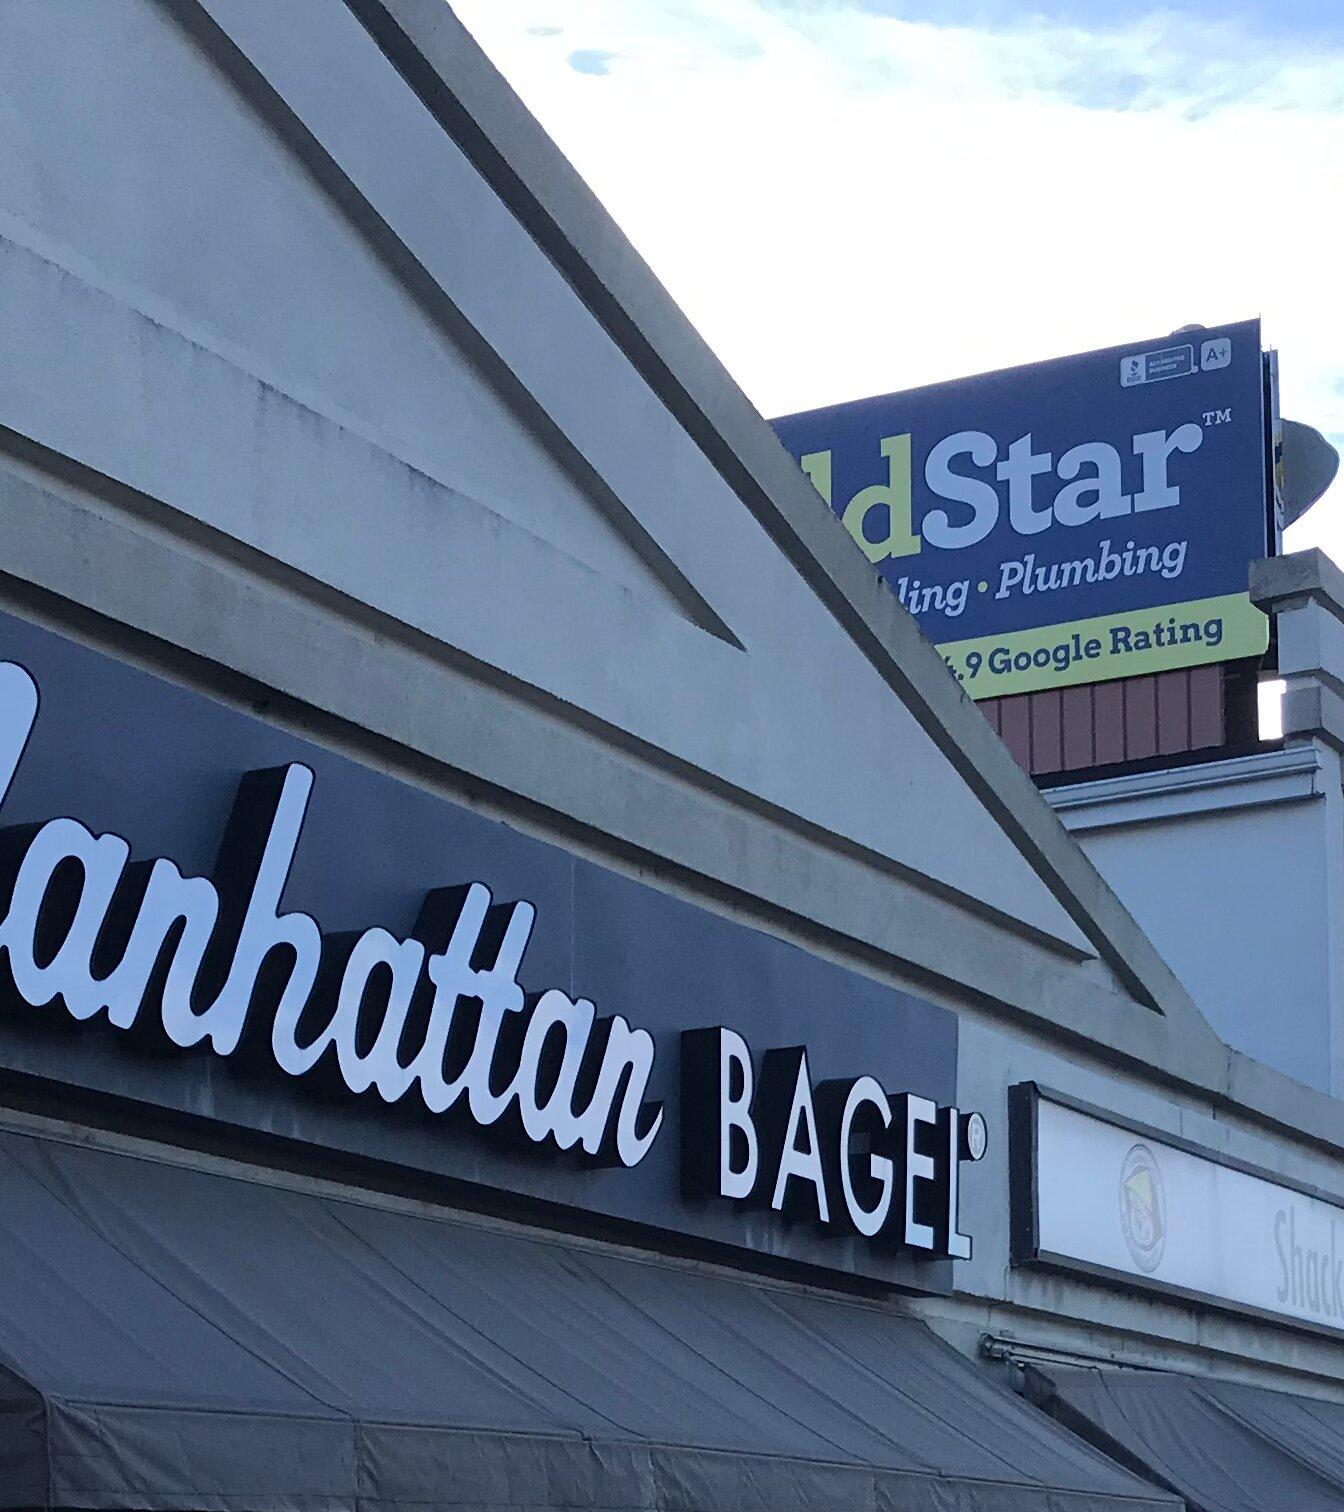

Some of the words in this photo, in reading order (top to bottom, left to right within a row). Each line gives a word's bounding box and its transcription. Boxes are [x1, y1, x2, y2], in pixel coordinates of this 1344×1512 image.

[994, 540, 1187, 600] Plumbing
[989, 634, 1101, 675] Google
[1109, 617, 1223, 655] Rating
